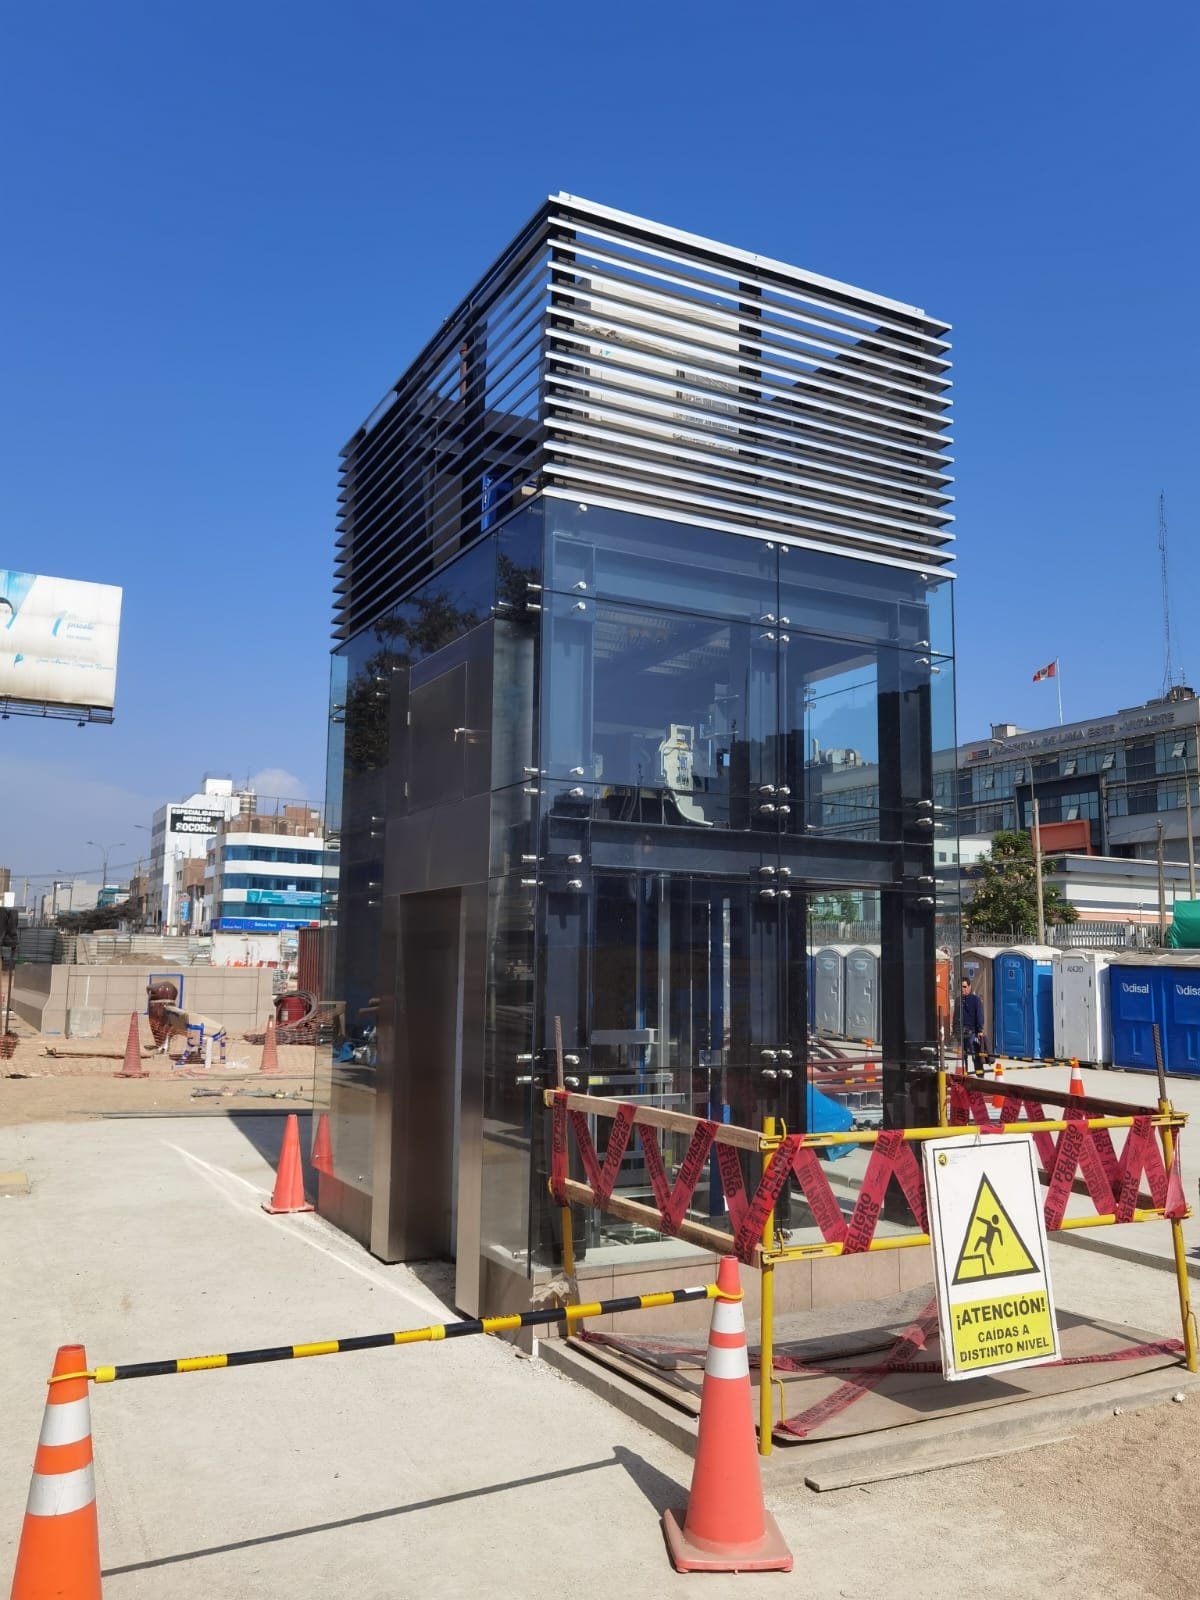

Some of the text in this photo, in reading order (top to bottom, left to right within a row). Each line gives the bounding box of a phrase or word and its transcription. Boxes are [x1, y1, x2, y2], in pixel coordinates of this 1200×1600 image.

[1129, 984, 1149, 994] disal
[612, 1122, 631, 1168] OBRAS
[686, 1125, 709, 1167] PASAR
[875, 1134, 891, 1155] NO
[1054, 1124, 1078, 1183] PELIGRO
[1064, 1132, 1084, 1182] OBRAS
[757, 1136, 795, 1201] PELIGRO
[843, 1192, 872, 1255] PELIGRO
[956, 1296, 1045, 1330] ¡ATENCIÓN!
[978, 1324, 1030, 1343] CAÍDAS A
[960, 1342, 1014, 1363] DISTINTO
[1016, 1336, 1049, 1353] NIVEL
